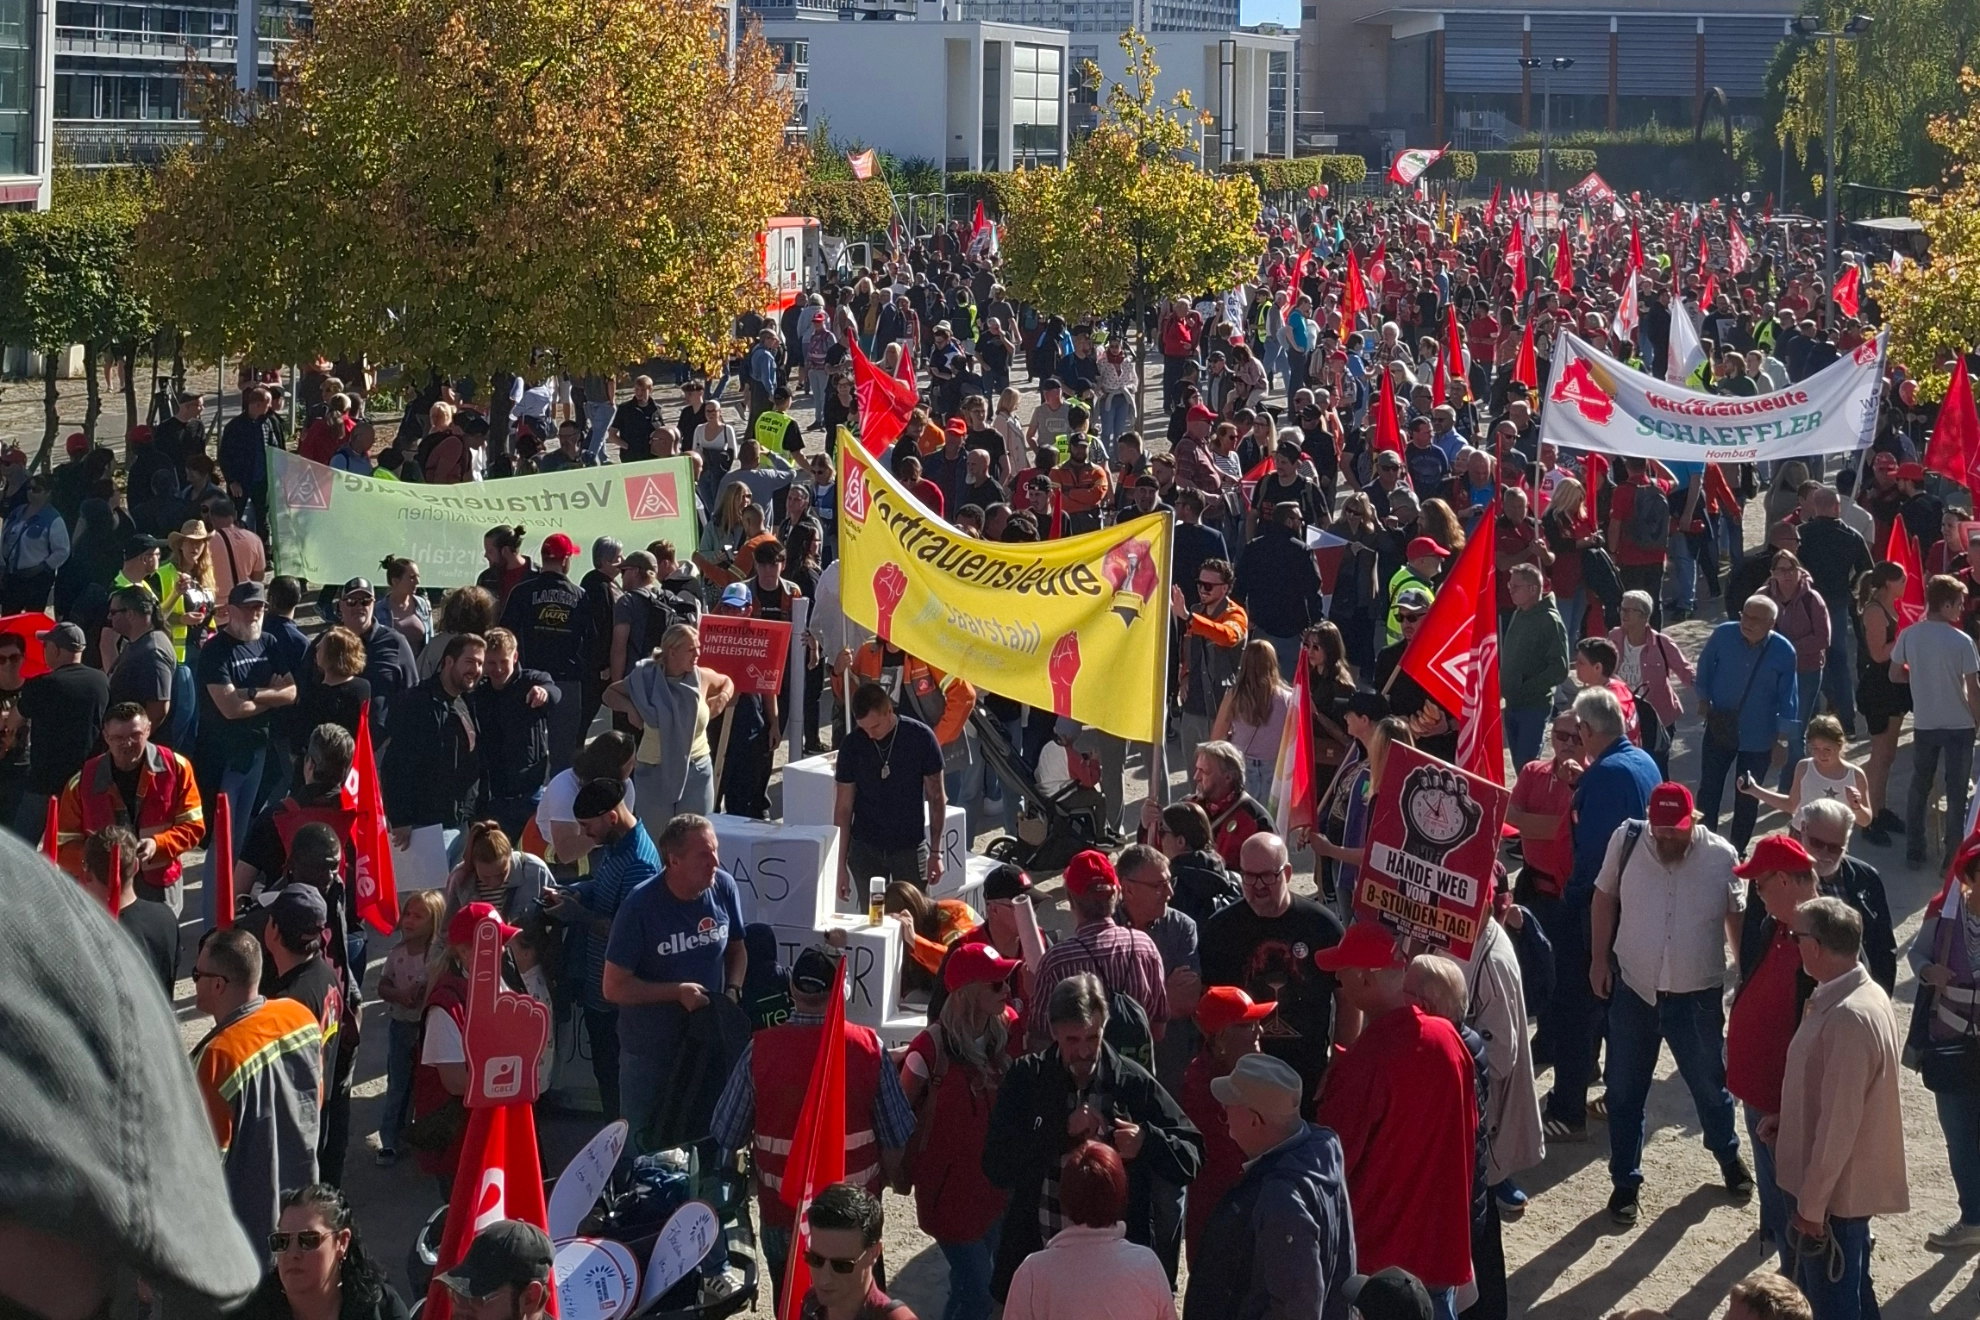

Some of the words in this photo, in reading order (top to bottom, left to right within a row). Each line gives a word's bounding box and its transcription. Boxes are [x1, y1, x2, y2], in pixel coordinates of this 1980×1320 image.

[1636, 410, 1823, 446] SCHAEFFLER
[1705, 448, 1758, 459] Homburg
[704, 634, 770, 648] UNTERLASSENE
[706, 624, 755, 637] NICHTSTUN
[757, 629, 770, 637] IST
[702, 645, 768, 658] HILFELEISTUNG.
[1385, 850, 1433, 888] HÄNDE
[1437, 870, 1469, 900] WEG
[1405, 882, 1431, 905] VOM
[1366, 884, 1472, 940] 8-STUNDEN-TAG!
[657, 925, 729, 956] ellesse
